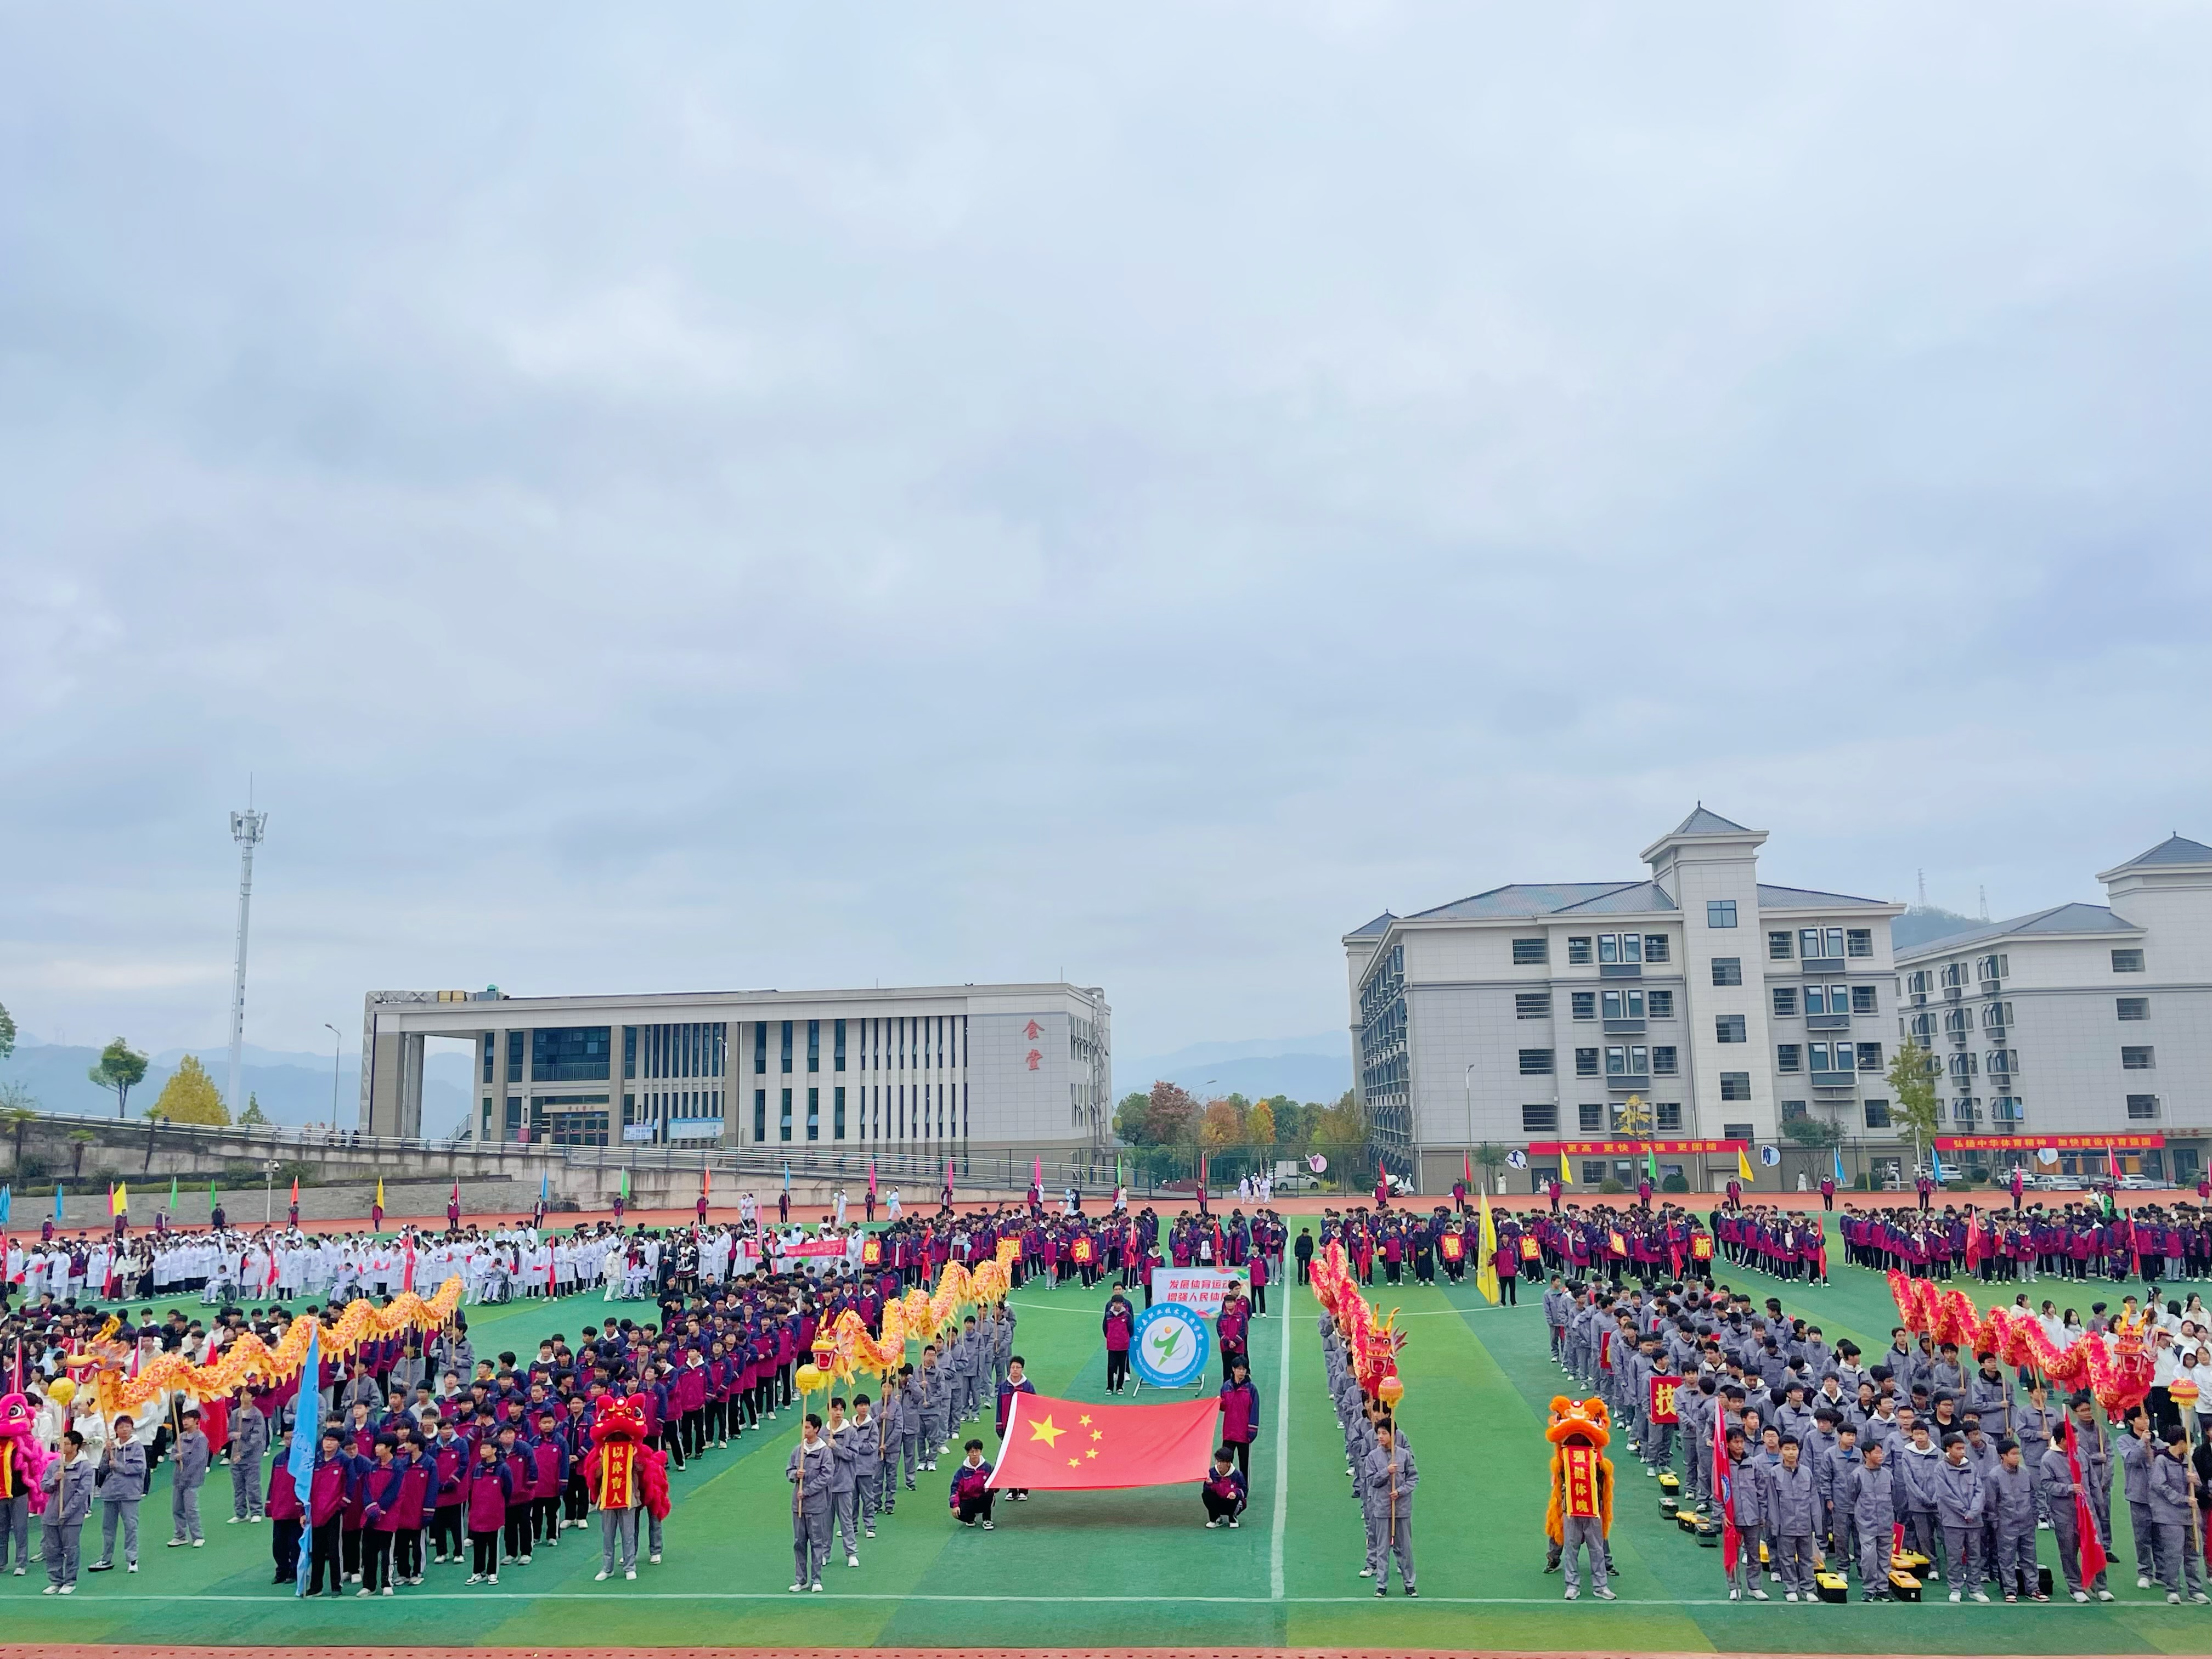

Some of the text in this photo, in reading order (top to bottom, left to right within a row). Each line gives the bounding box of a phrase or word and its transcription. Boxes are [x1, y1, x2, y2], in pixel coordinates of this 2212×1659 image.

[1023, 1019, 1045, 1070] 食堂
[1566, 1142, 1717, 1153] 更高 更快 更强 更团结
[1953, 1137, 2151, 1148] 弘扬中华体育精神 加快建设体育强国
[864, 1243, 879, 1261] 数
[1075, 1240, 1090, 1259] 动
[1444, 1237, 1459, 1256] 智
[1522, 1238, 1539, 1257] 能
[1695, 1237, 1711, 1257] 新
[1655, 1383, 1677, 1416] 技
[610, 1446, 624, 1504] 以体育人
[1572, 1450, 1589, 1513] 强健体魄
